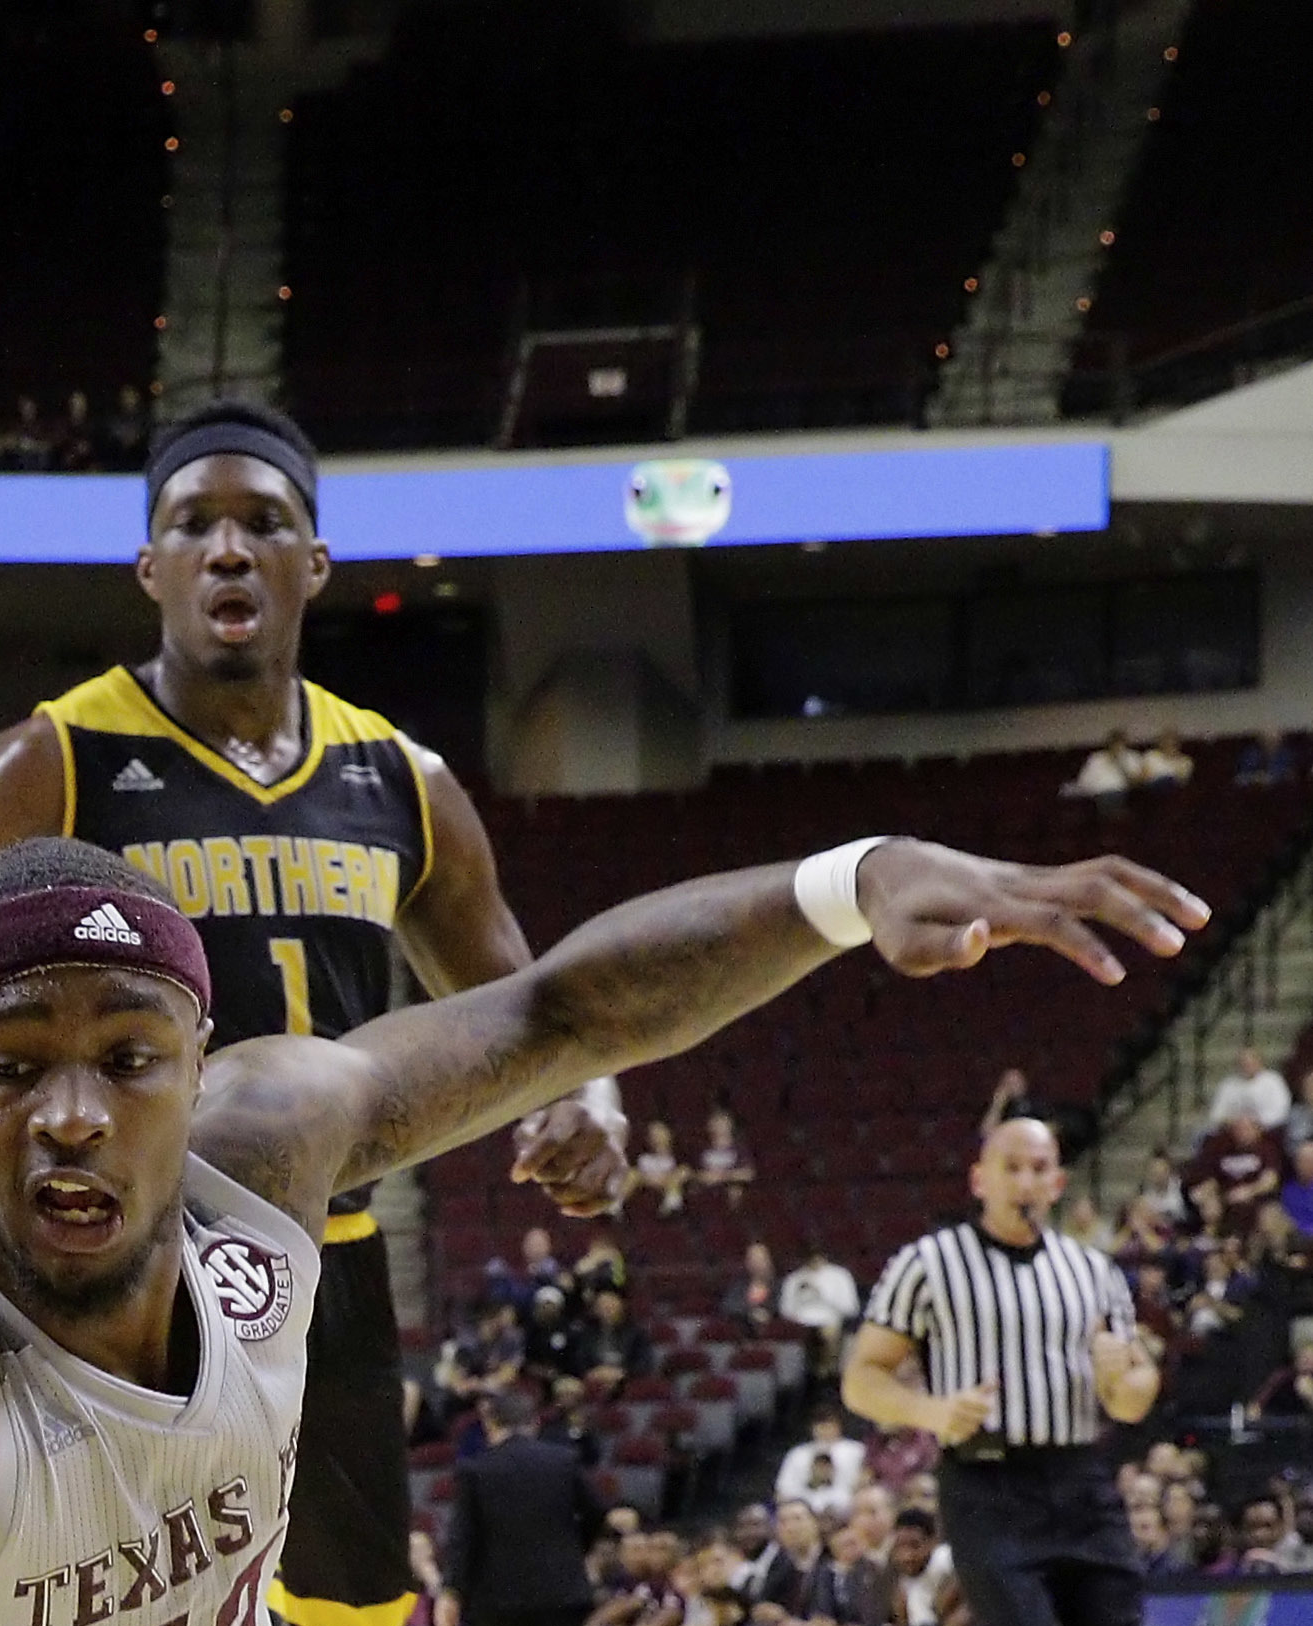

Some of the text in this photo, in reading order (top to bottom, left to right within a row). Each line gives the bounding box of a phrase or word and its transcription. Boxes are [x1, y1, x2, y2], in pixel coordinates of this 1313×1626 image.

[73, 925, 142, 946] adidas
[269, 937, 314, 1036] 1
[205, 1243, 270, 1314] SEC
[240, 1278, 290, 1338] GRADUATE
